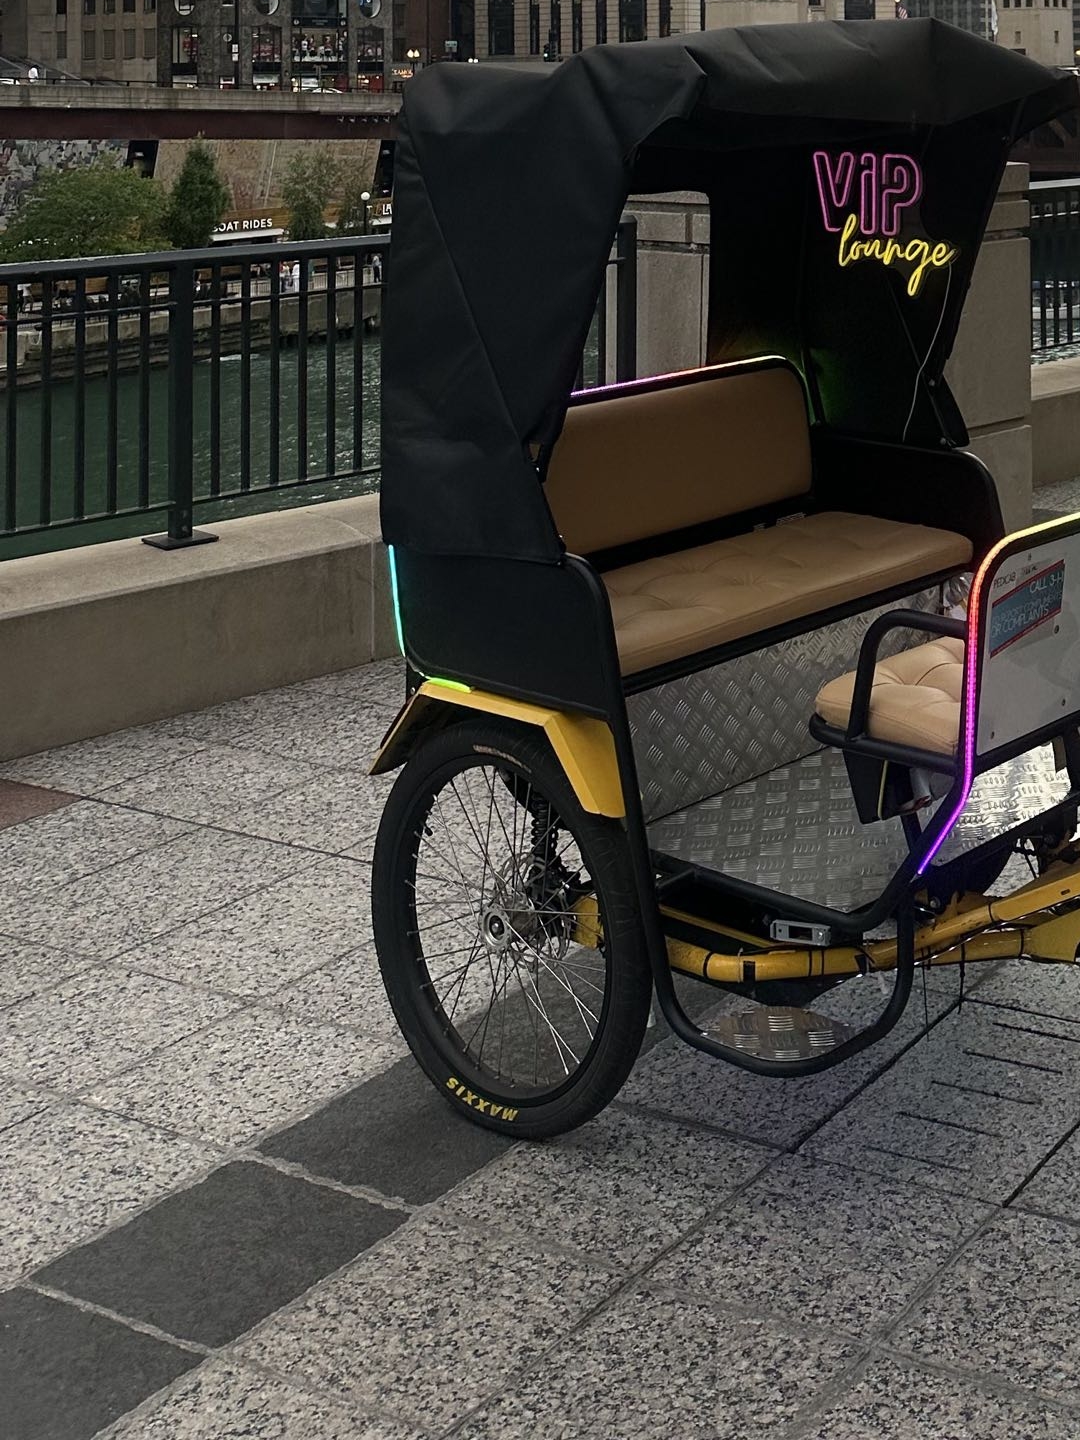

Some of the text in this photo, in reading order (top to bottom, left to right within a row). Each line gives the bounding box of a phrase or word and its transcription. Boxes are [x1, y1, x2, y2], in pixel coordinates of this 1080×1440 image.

[242, 218, 273, 229] RIDES
[838, 213, 956, 296] lounge
[1029, 578, 1047, 593] CALL
[446, 1077, 519, 1121] MAXXIS
